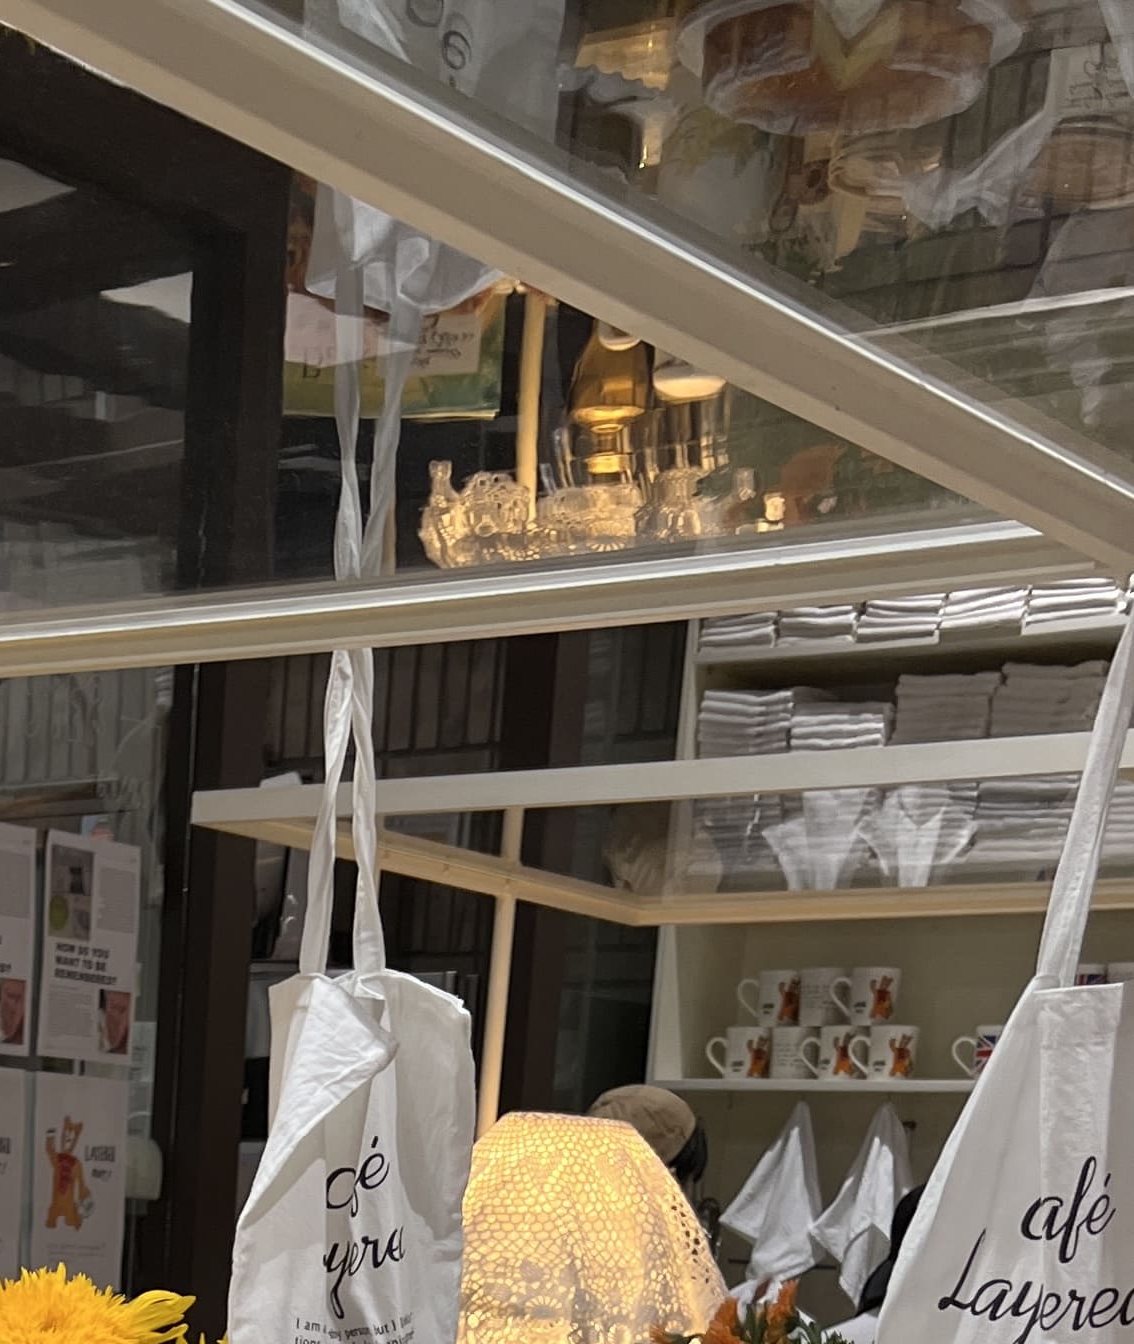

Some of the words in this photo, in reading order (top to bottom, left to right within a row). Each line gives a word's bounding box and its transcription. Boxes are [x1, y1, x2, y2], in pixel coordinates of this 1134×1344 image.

[56, 942, 75, 953] HOW
[92, 948, 109, 959] YOU
[56, 956, 80, 968] WANT
[83, 959, 93, 970] TO
[95, 962, 106, 973] BE
